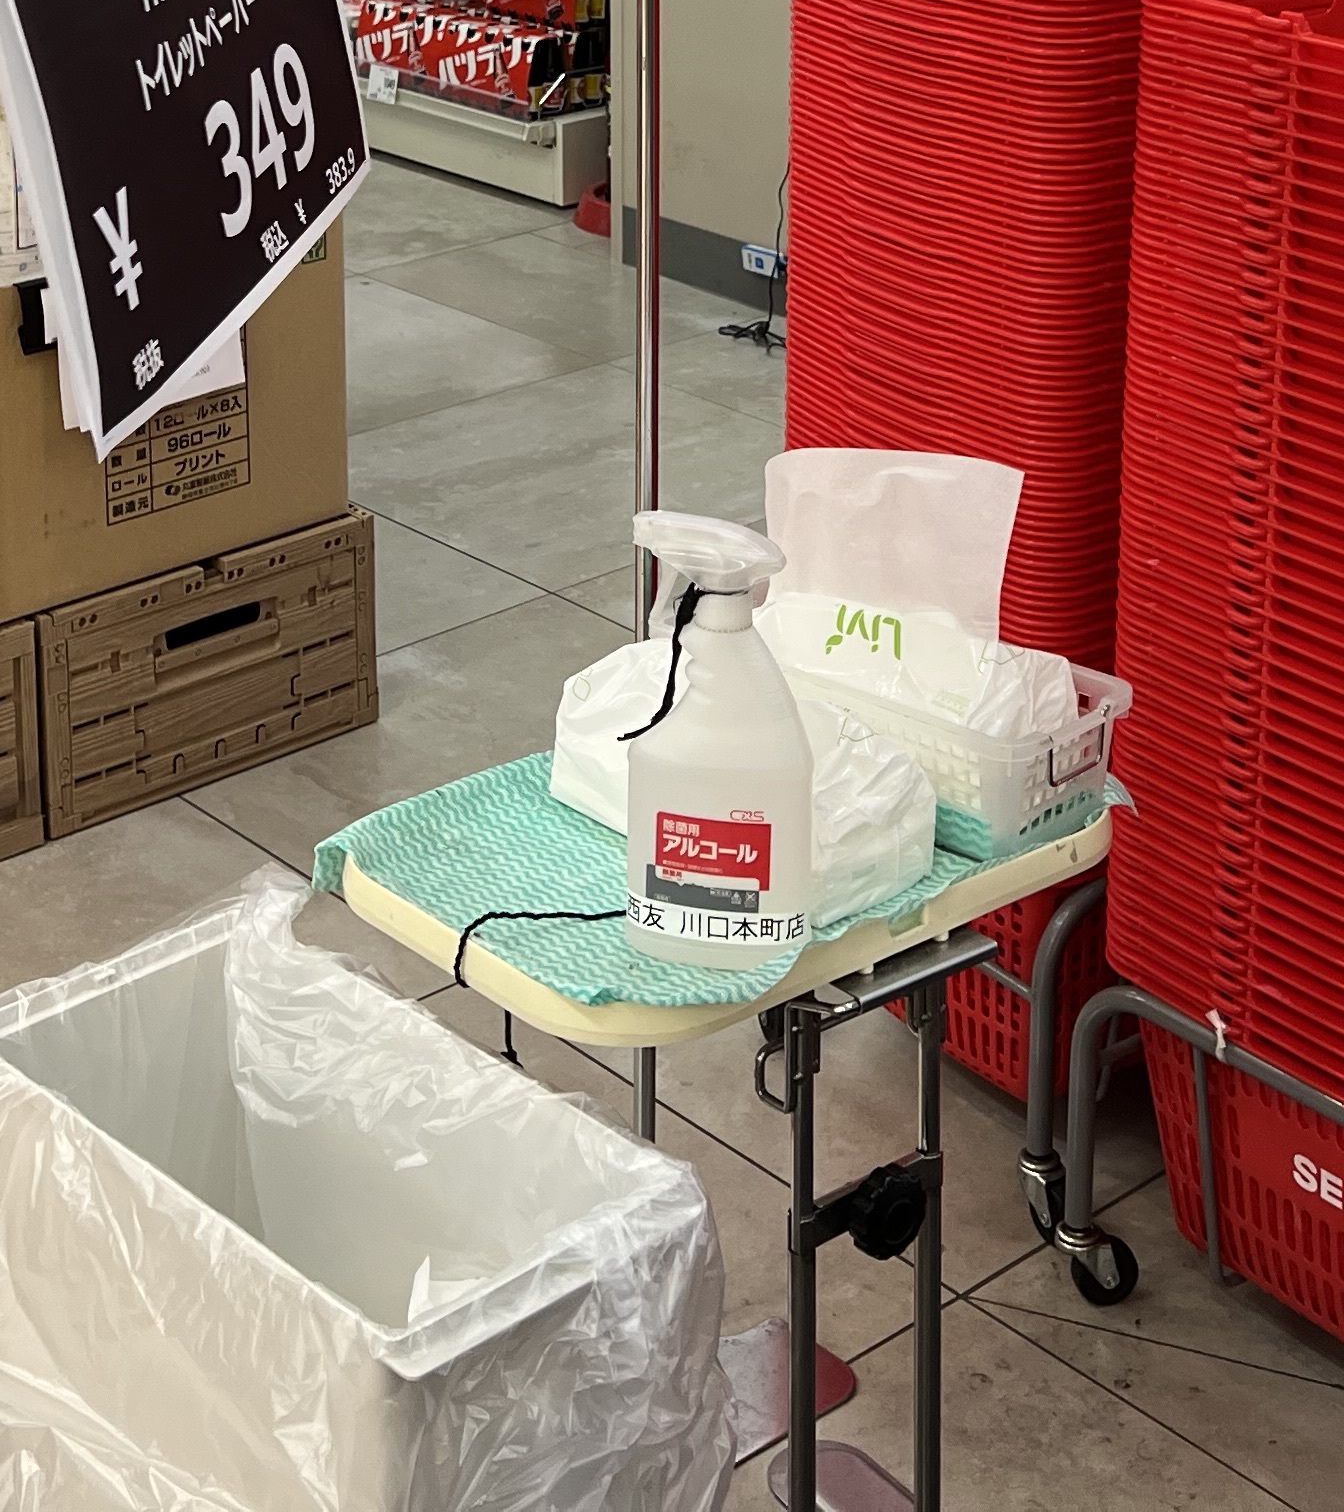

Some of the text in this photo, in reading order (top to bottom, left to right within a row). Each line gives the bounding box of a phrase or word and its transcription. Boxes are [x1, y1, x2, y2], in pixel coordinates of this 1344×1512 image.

[92, 41, 320, 312] ¥ 349
[259, 219, 291, 264] 税込
[131, 338, 165, 391] 税抜
[167, 422, 232, 453] 96ロール
[174, 449, 226, 476] プリント
[111, 473, 148, 493] ロール
[662, 818, 701, 837] 除菌用
[662, 832, 759, 864] アルコール
[627, 892, 805, 942] 西友 川口本町店
